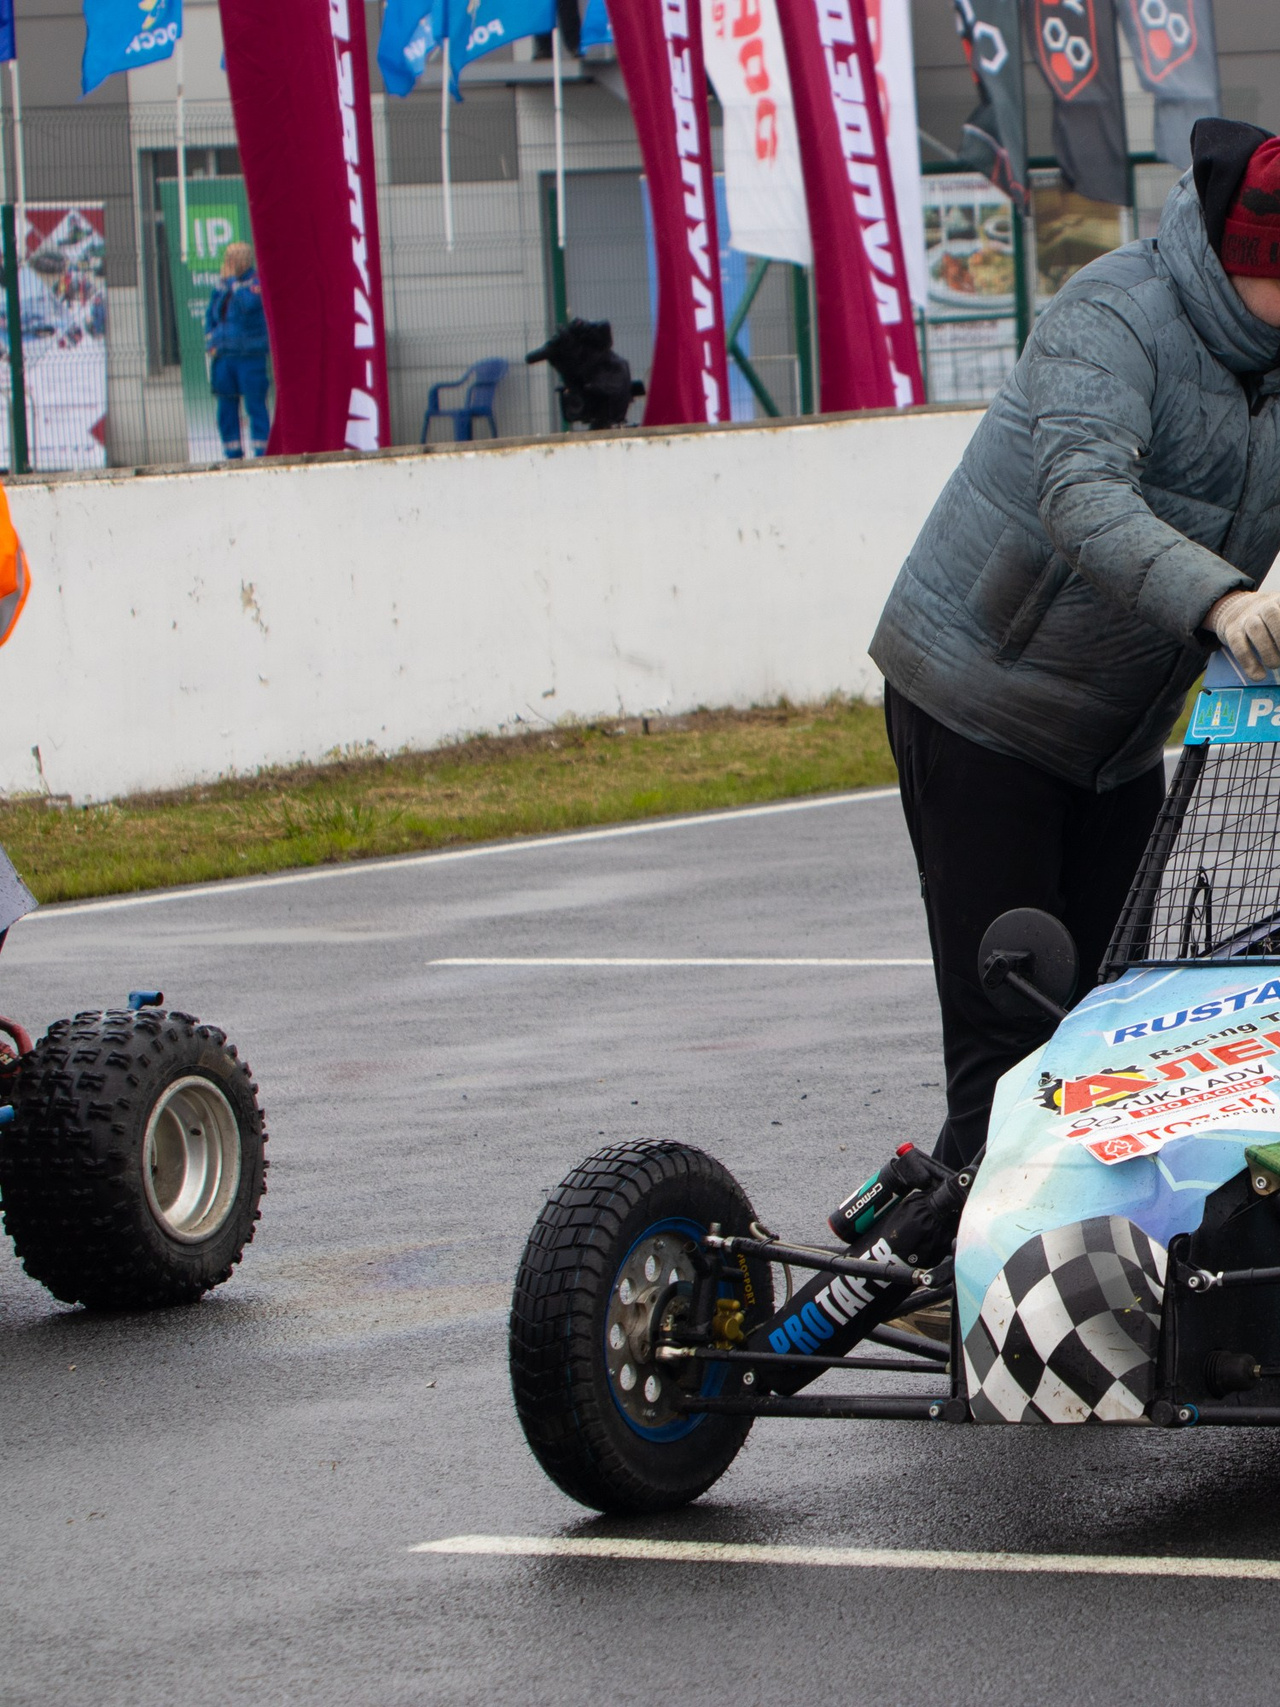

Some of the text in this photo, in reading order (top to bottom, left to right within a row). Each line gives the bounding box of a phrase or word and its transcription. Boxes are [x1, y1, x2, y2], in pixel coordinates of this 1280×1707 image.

[194, 217, 233, 258] IP
[1148, 1022, 1259, 1061] Racing
[1207, 1063, 1267, 1089] ADV
[1139, 1100, 1184, 1117] PRO
[1188, 1079, 1266, 1107] RACING
[1188, 1106, 1276, 1129] ECHNOLOGY
[844, 1181, 884, 1220] CFMOTO
